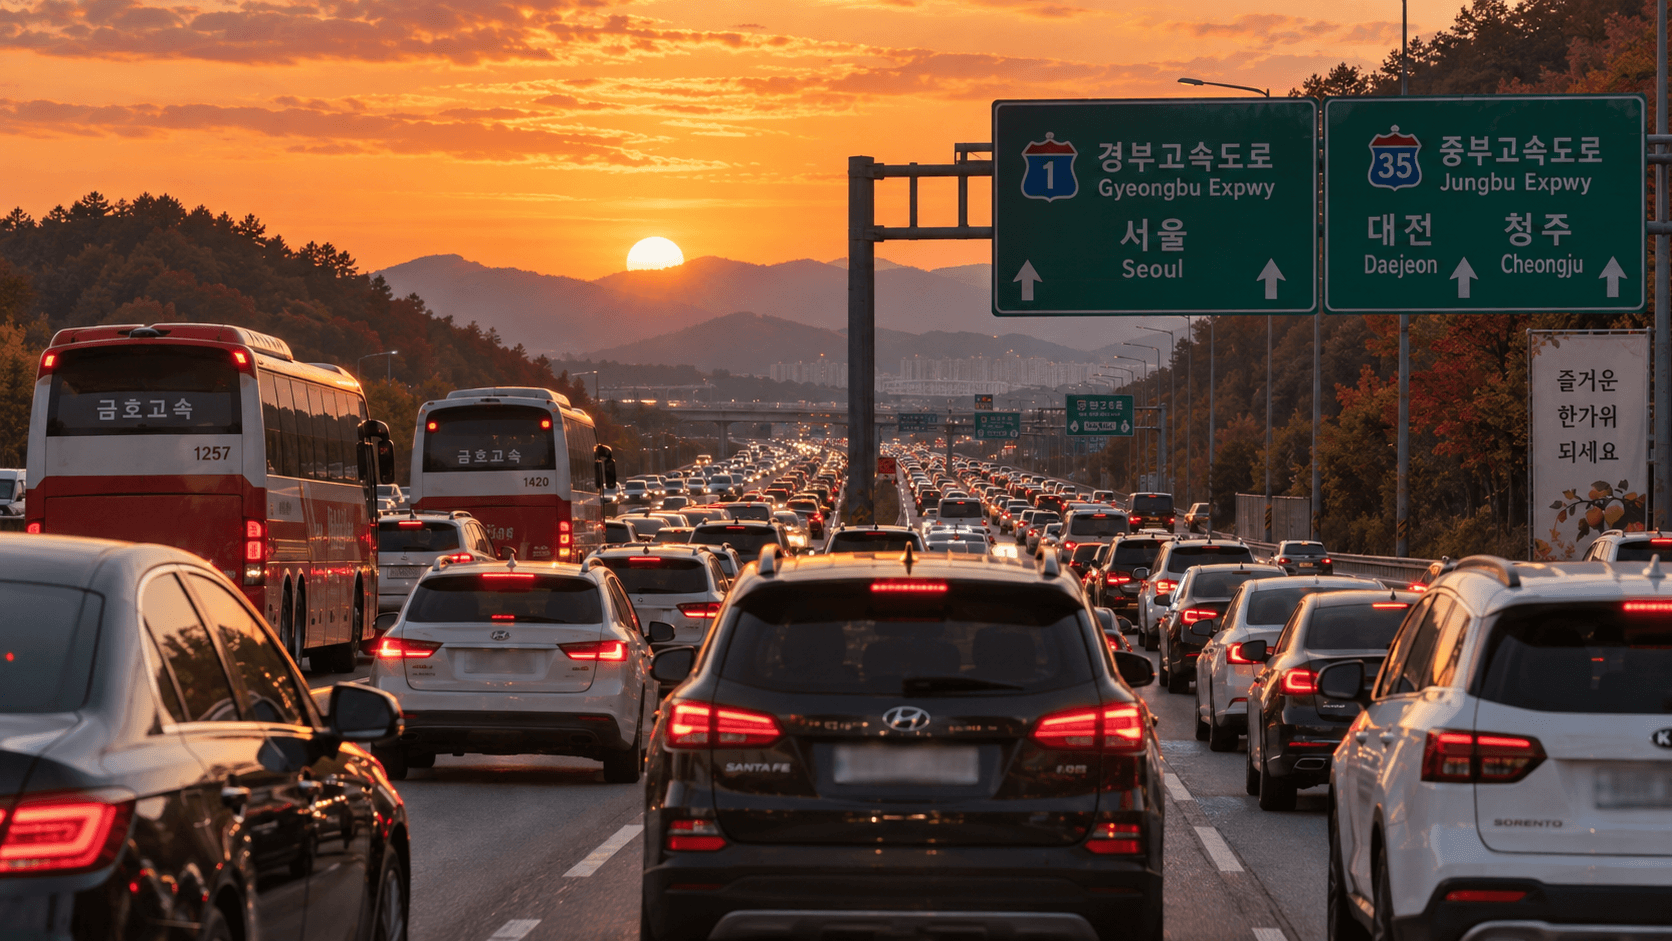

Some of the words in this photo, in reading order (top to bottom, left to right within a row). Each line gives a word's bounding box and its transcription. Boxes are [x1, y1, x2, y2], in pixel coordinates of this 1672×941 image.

[1097, 141, 1273, 173] 경부고속도로
[1439, 135, 1603, 167] 중부고속도로
[1042, 160, 1055, 190] 1
[1377, 152, 1413, 179] 35
[1098, 177, 1201, 201] Gyeongbu
[1209, 178, 1276, 200] Expwy
[1439, 172, 1515, 196] Jungbu
[1525, 173, 1593, 196] Expwy
[1120, 218, 1188, 252] 서울
[1367, 212, 1432, 247] 대전
[1504, 212, 1572, 247] 청주
[1122, 258, 1183, 279] Seoul
[1364, 253, 1438, 279] Daejeon
[1501, 253, 1583, 279] Cheongju
[1556, 368, 1619, 393] 즐거운
[96, 397, 193, 421] 금호고속
[1557, 404, 1617, 429] 한가위
[194, 446, 231, 461] 1257
[457, 448, 522, 464] 금호고속
[1558, 440, 1620, 464] 되세요
[523, 476, 550, 488] 1420
[725, 762, 771, 773] SANTA
[771, 762, 791, 773] FE
[1493, 818, 1563, 829] SORENTO
